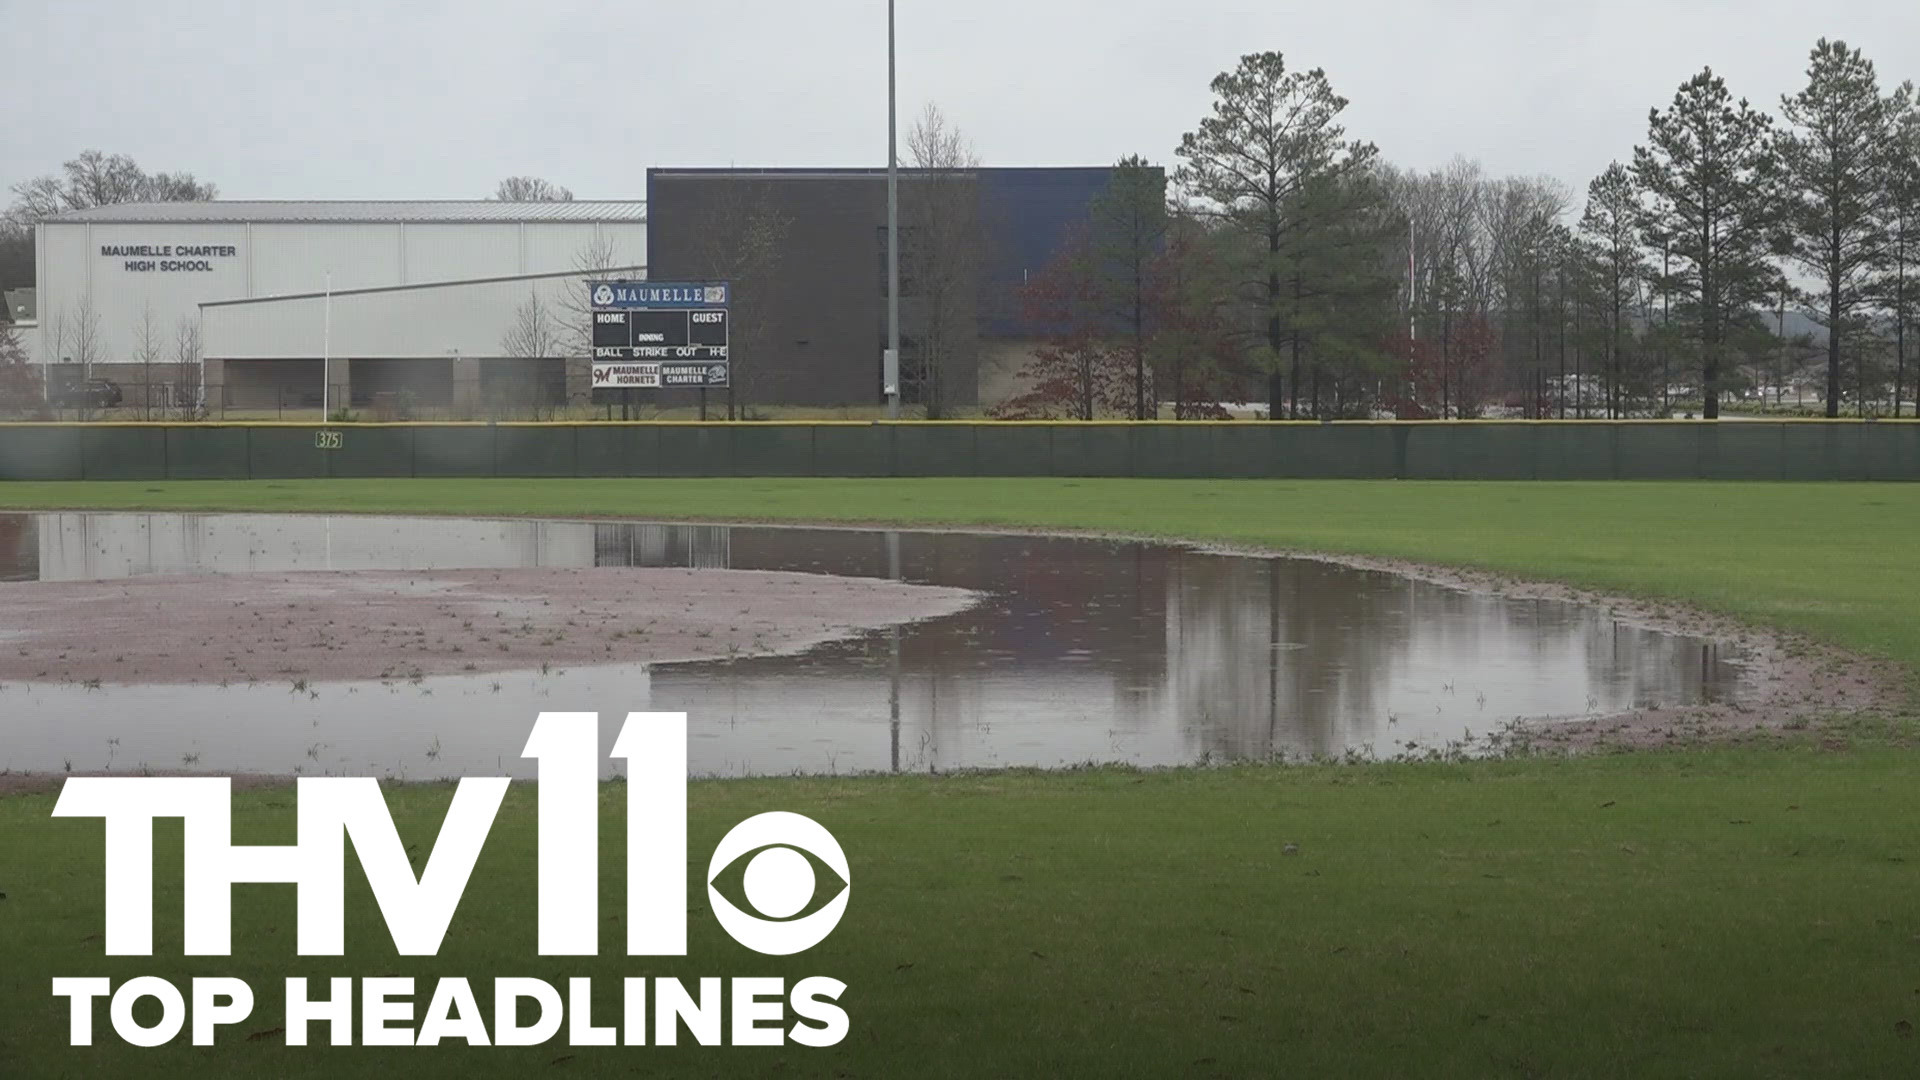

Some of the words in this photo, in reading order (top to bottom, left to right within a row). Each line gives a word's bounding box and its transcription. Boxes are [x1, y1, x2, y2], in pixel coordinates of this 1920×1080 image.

[101, 245, 171, 256] MAUMELLE
[175, 245, 236, 256] CHARTER
[125, 261, 156, 271] HIGH
[160, 260, 213, 271] SCHOOL
[616, 288, 702, 301] MAUMELLE
[597, 313, 625, 323] HOME
[692, 313, 723, 323] GUEST
[638, 332, 664, 342] INNING
[596, 347, 623, 357] BALL
[632, 347, 668, 357] STRIKE
[676, 347, 697, 357] OUT
[612, 365, 659, 375] MAUMELLE
[662, 366, 707, 375] MAUMELLE
[616, 375, 656, 384] HORNETS
[666, 375, 703, 383] CHARTER
[319, 431, 339, 448] 375
